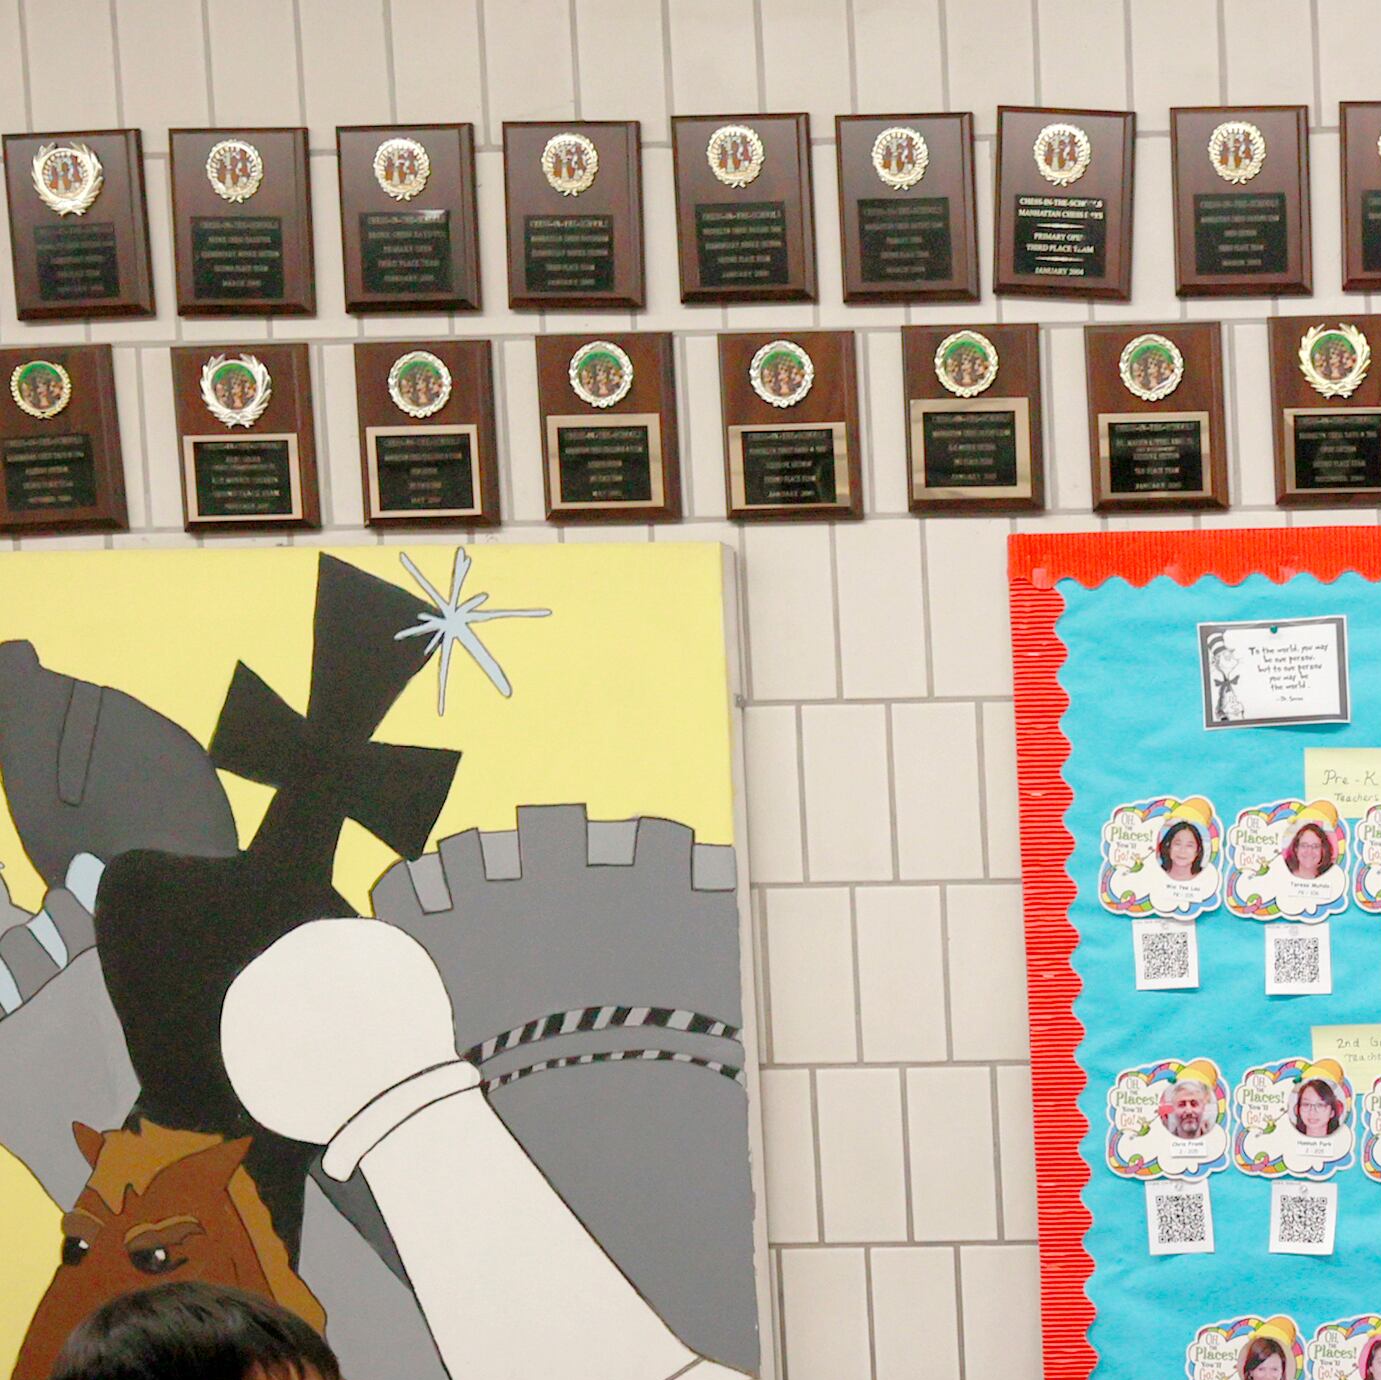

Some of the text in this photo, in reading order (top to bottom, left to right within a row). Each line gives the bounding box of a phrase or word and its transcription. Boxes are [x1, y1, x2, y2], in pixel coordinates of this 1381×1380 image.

[1262, 645, 1275, 654] the
[1334, 792, 1380, 803] Teachers
[1336, 1038, 1360, 1049] 2nd
[1314, 1345, 1357, 1360] Places!
[1317, 1365, 1333, 1379] Go!
